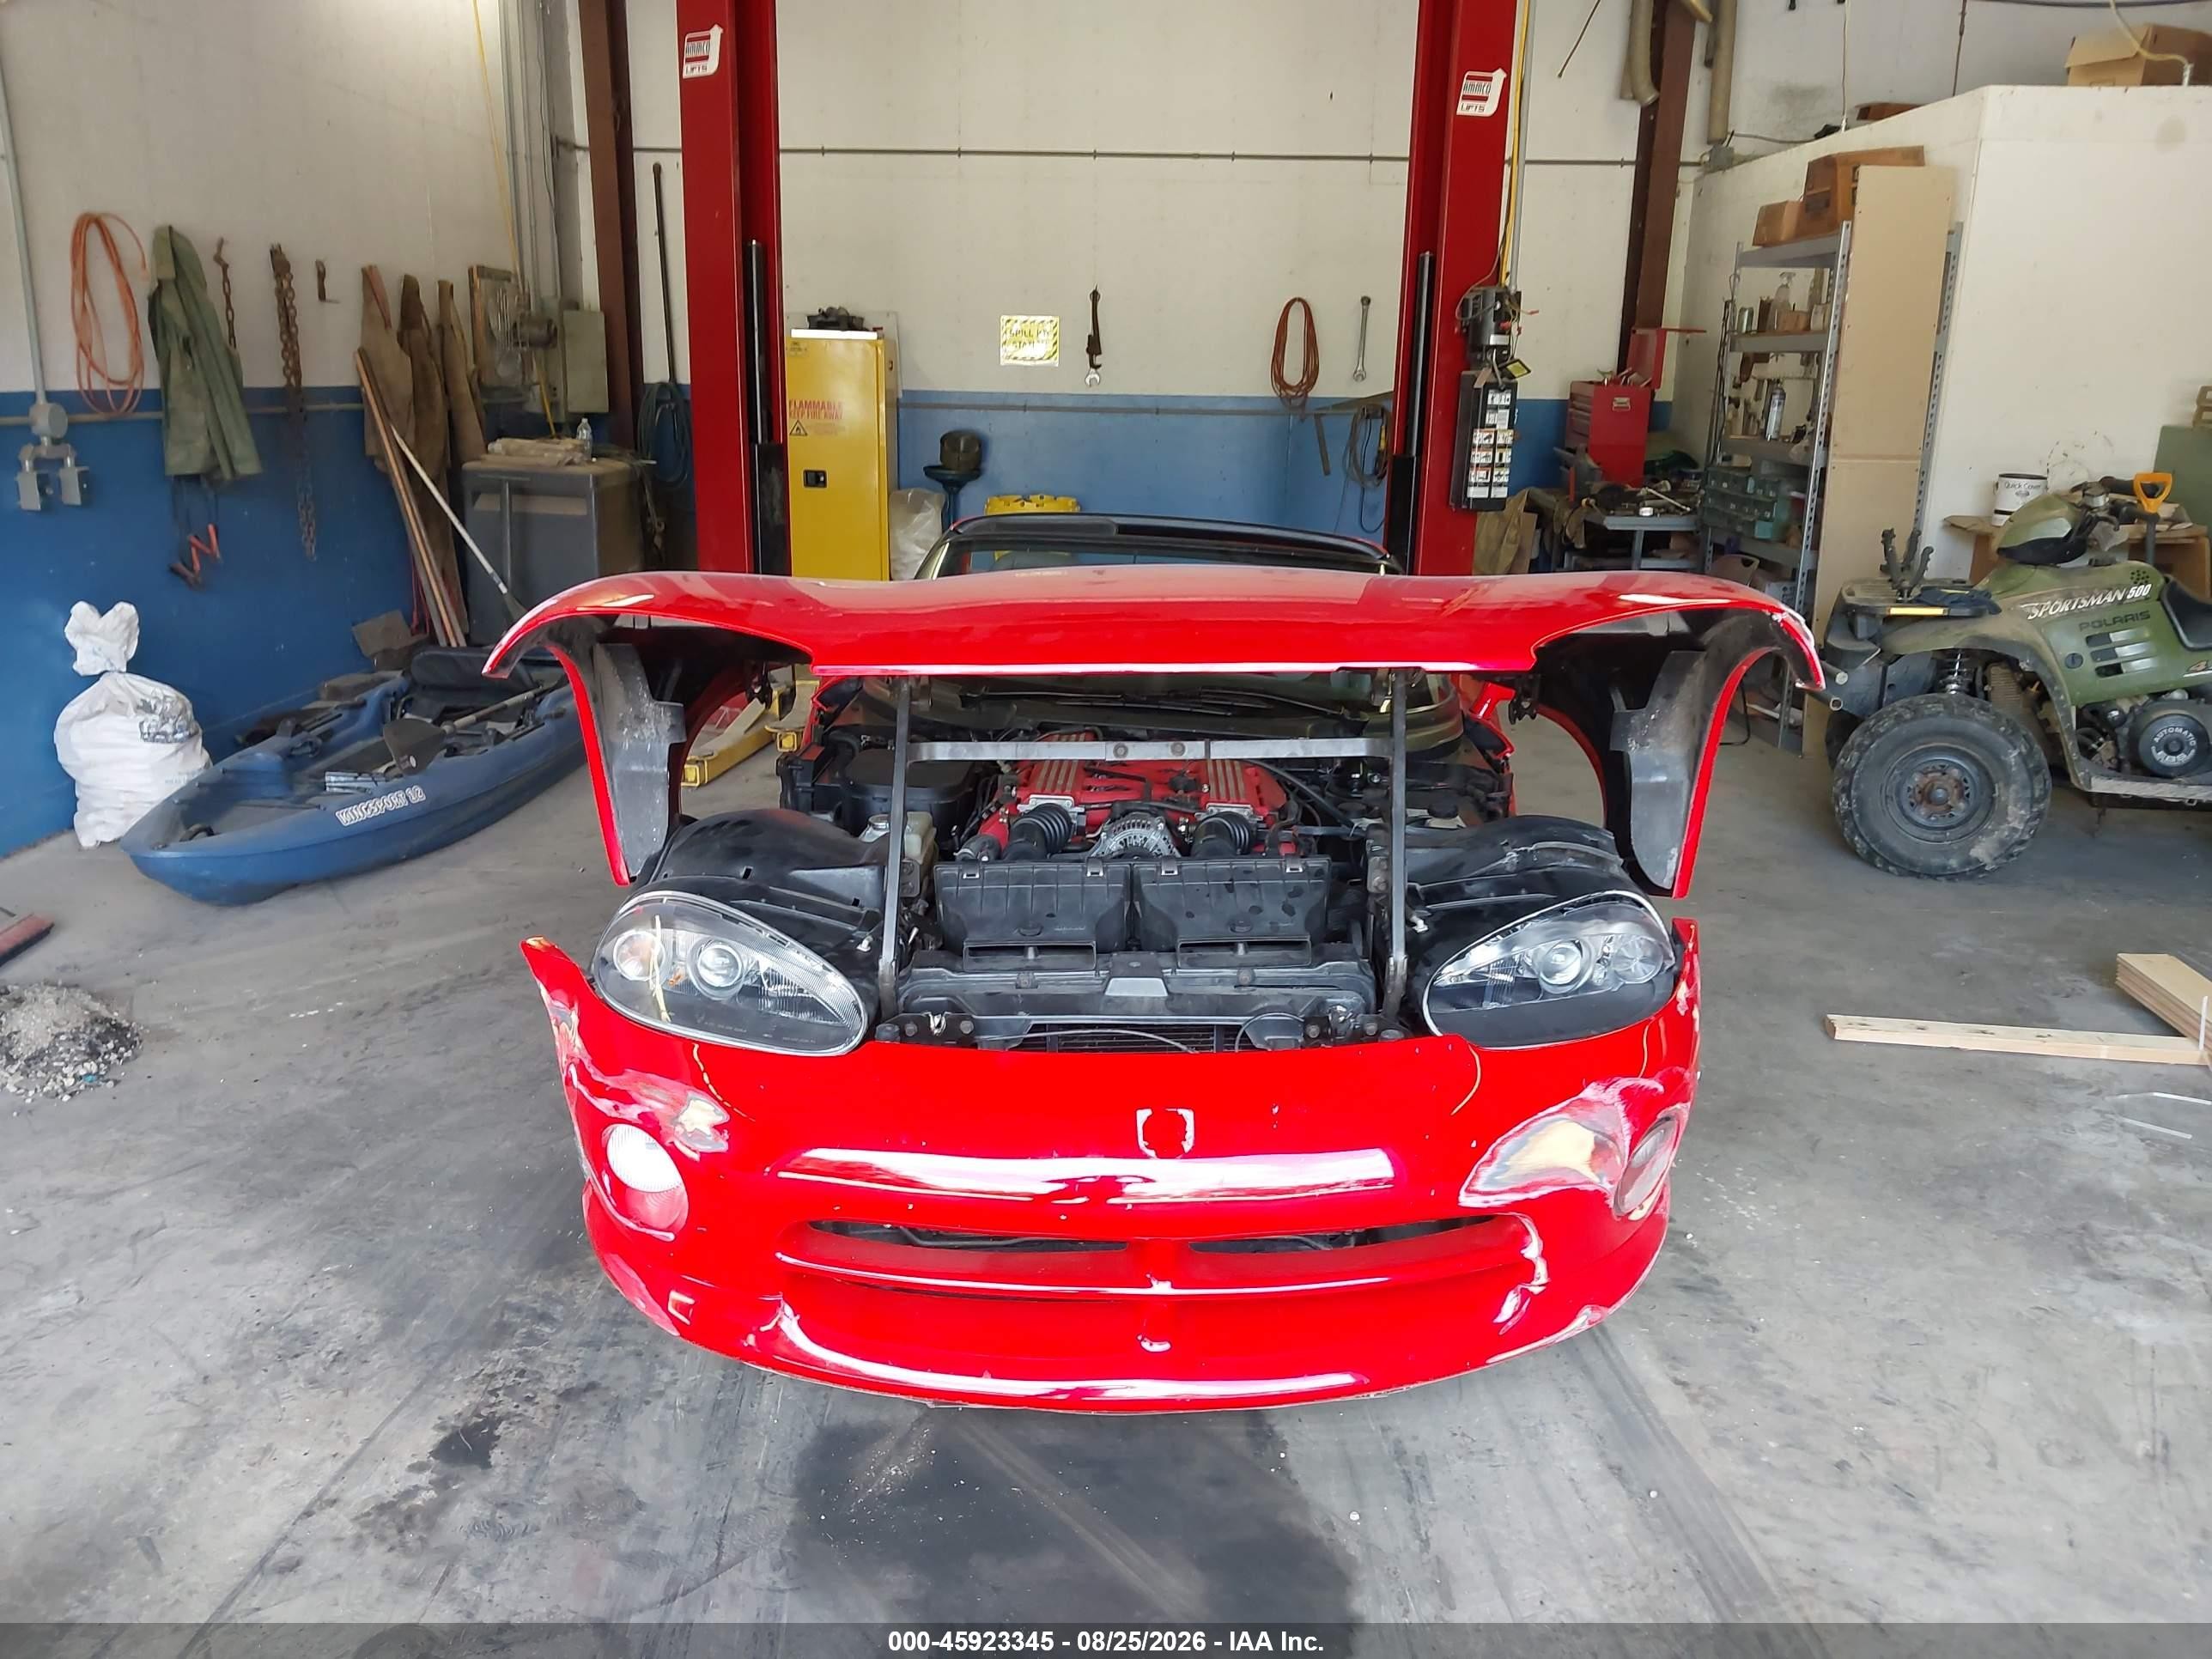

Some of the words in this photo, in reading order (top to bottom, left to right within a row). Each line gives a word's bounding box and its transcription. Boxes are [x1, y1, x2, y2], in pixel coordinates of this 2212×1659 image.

[2020, 587, 2127, 620] SPORTSMAN
[2126, 583, 2153, 599] 500
[2079, 611, 2151, 632] POLARIS
[2154, 726, 2197, 746] AUTOMATIC
